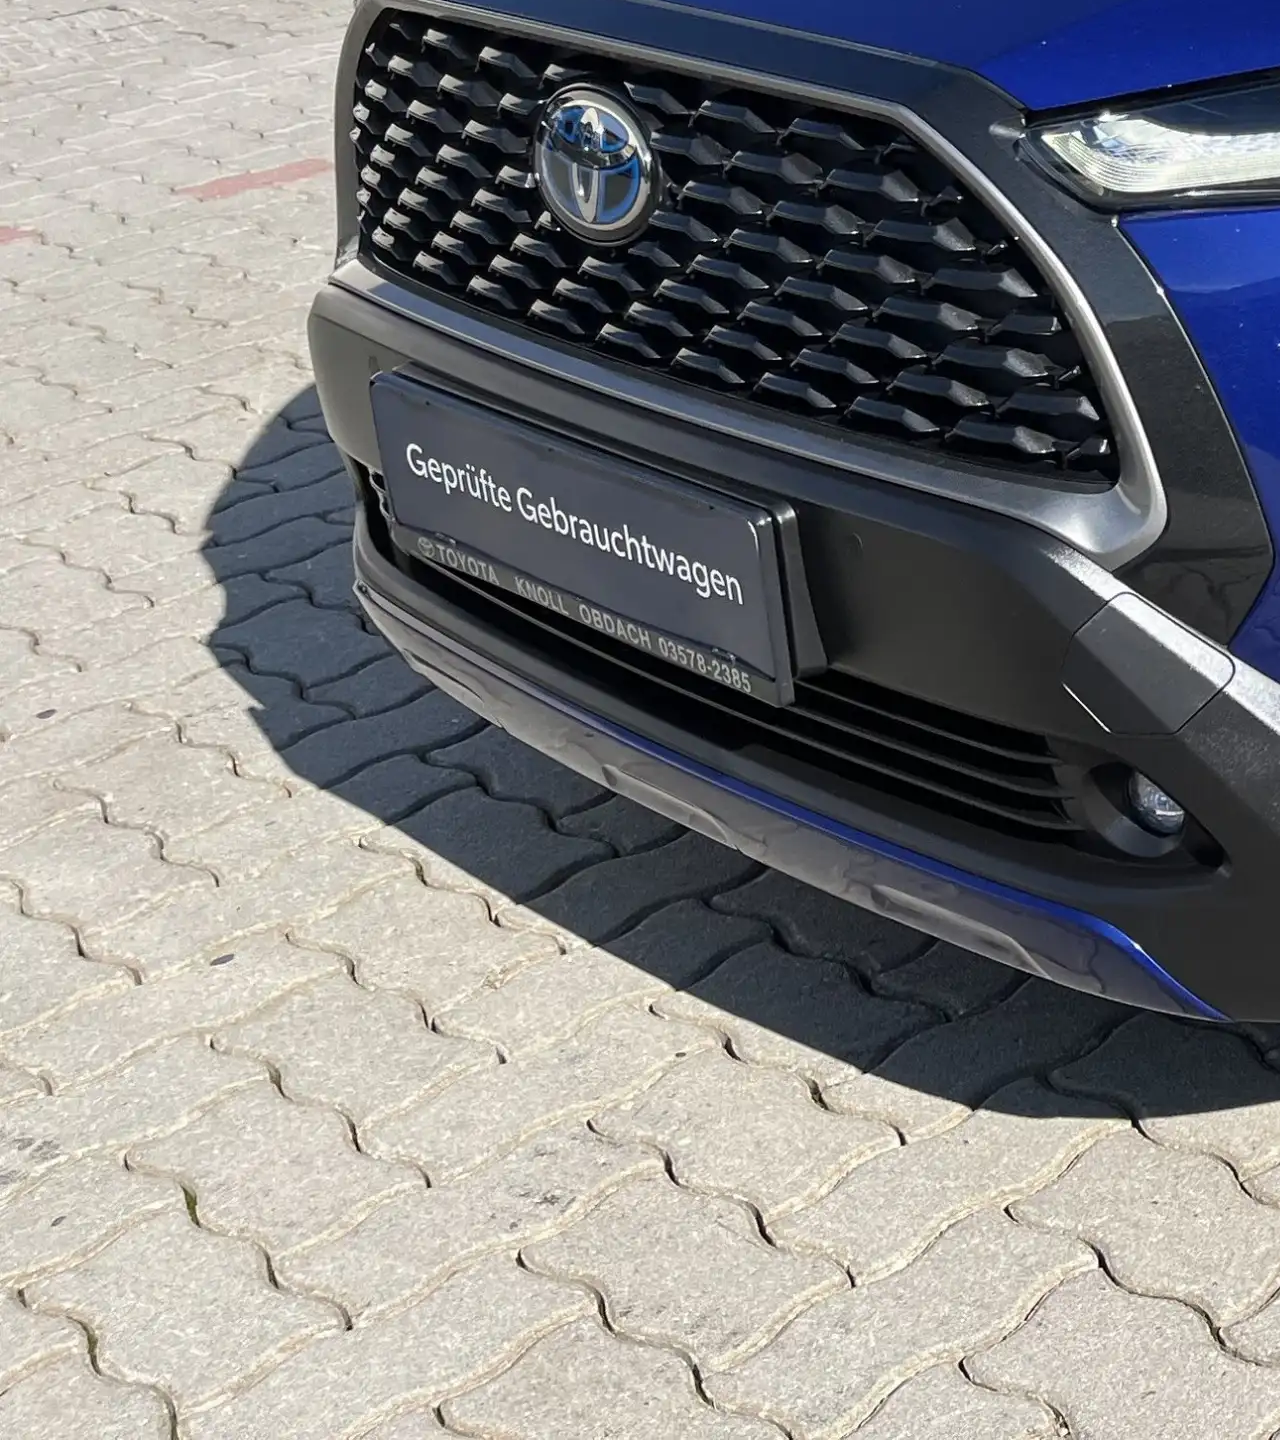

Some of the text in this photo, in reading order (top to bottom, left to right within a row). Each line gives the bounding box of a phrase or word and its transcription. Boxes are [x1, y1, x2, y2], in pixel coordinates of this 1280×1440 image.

[405, 442, 744, 605] Geprüfte Gebrauchtwagen
[435, 544, 751, 693] TOYOTA KNOLL OBDACH 03578-2385
